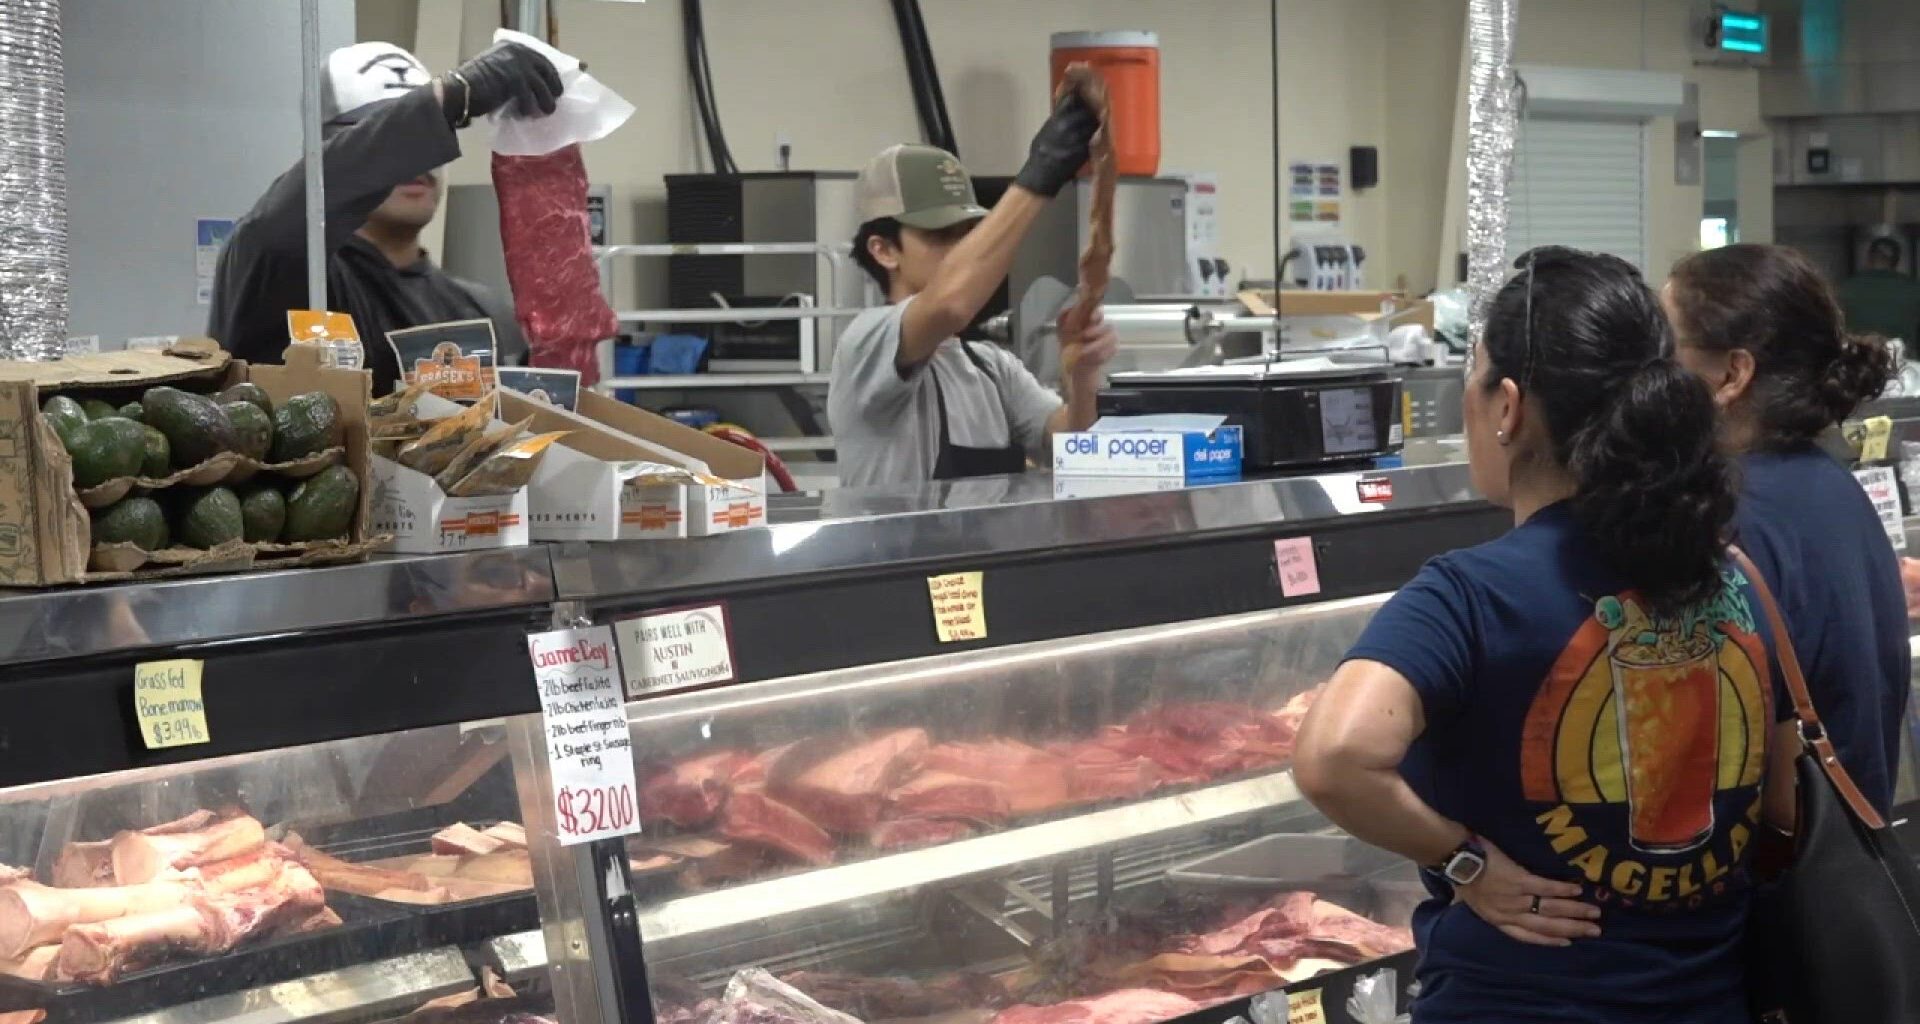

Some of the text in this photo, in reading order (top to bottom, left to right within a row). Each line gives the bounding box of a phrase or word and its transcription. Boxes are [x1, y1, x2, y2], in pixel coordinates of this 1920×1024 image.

[1065, 435, 1169, 459] deli paper
[634, 619, 706, 644] PAIRS WELL WITH
[531, 638, 611, 669] Game Day
[653, 641, 694, 663] AUSTIN
[136, 668, 167, 690] Grass
[630, 673, 673, 691] CABERNET
[138, 696, 168, 718] Bone
[579, 755, 604, 772] ring
